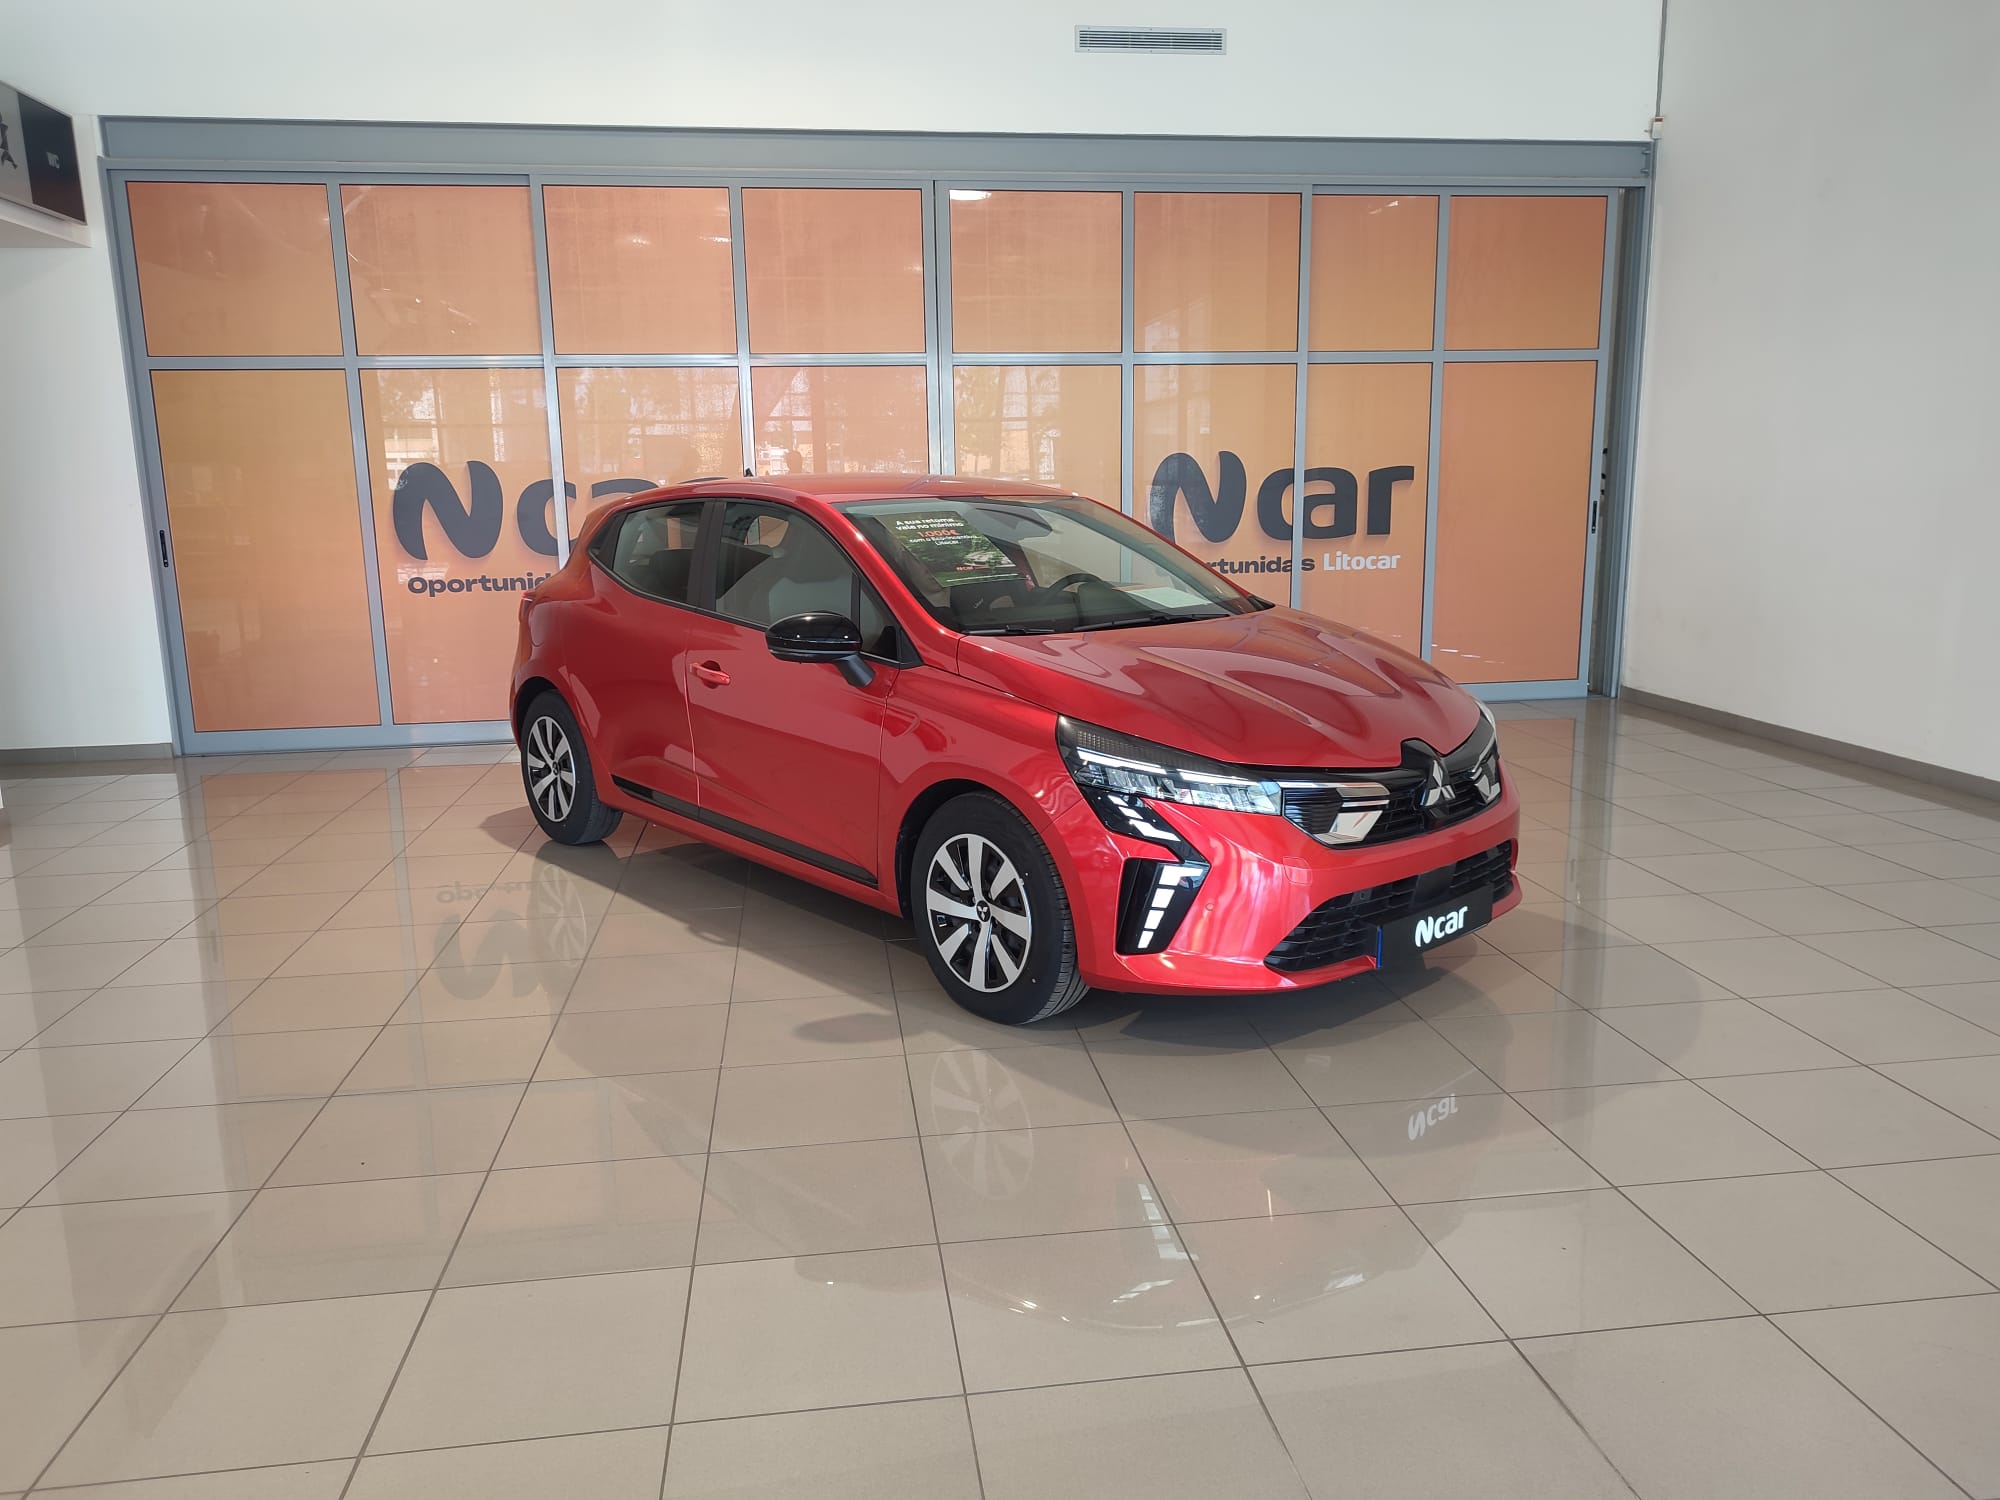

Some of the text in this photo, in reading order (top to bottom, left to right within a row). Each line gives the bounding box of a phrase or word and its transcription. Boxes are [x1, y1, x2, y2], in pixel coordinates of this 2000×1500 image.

[1150, 451, 1415, 545] Ncar
[1323, 551, 1400, 571] Litocar
[1415, 905, 1468, 947] Ncar
